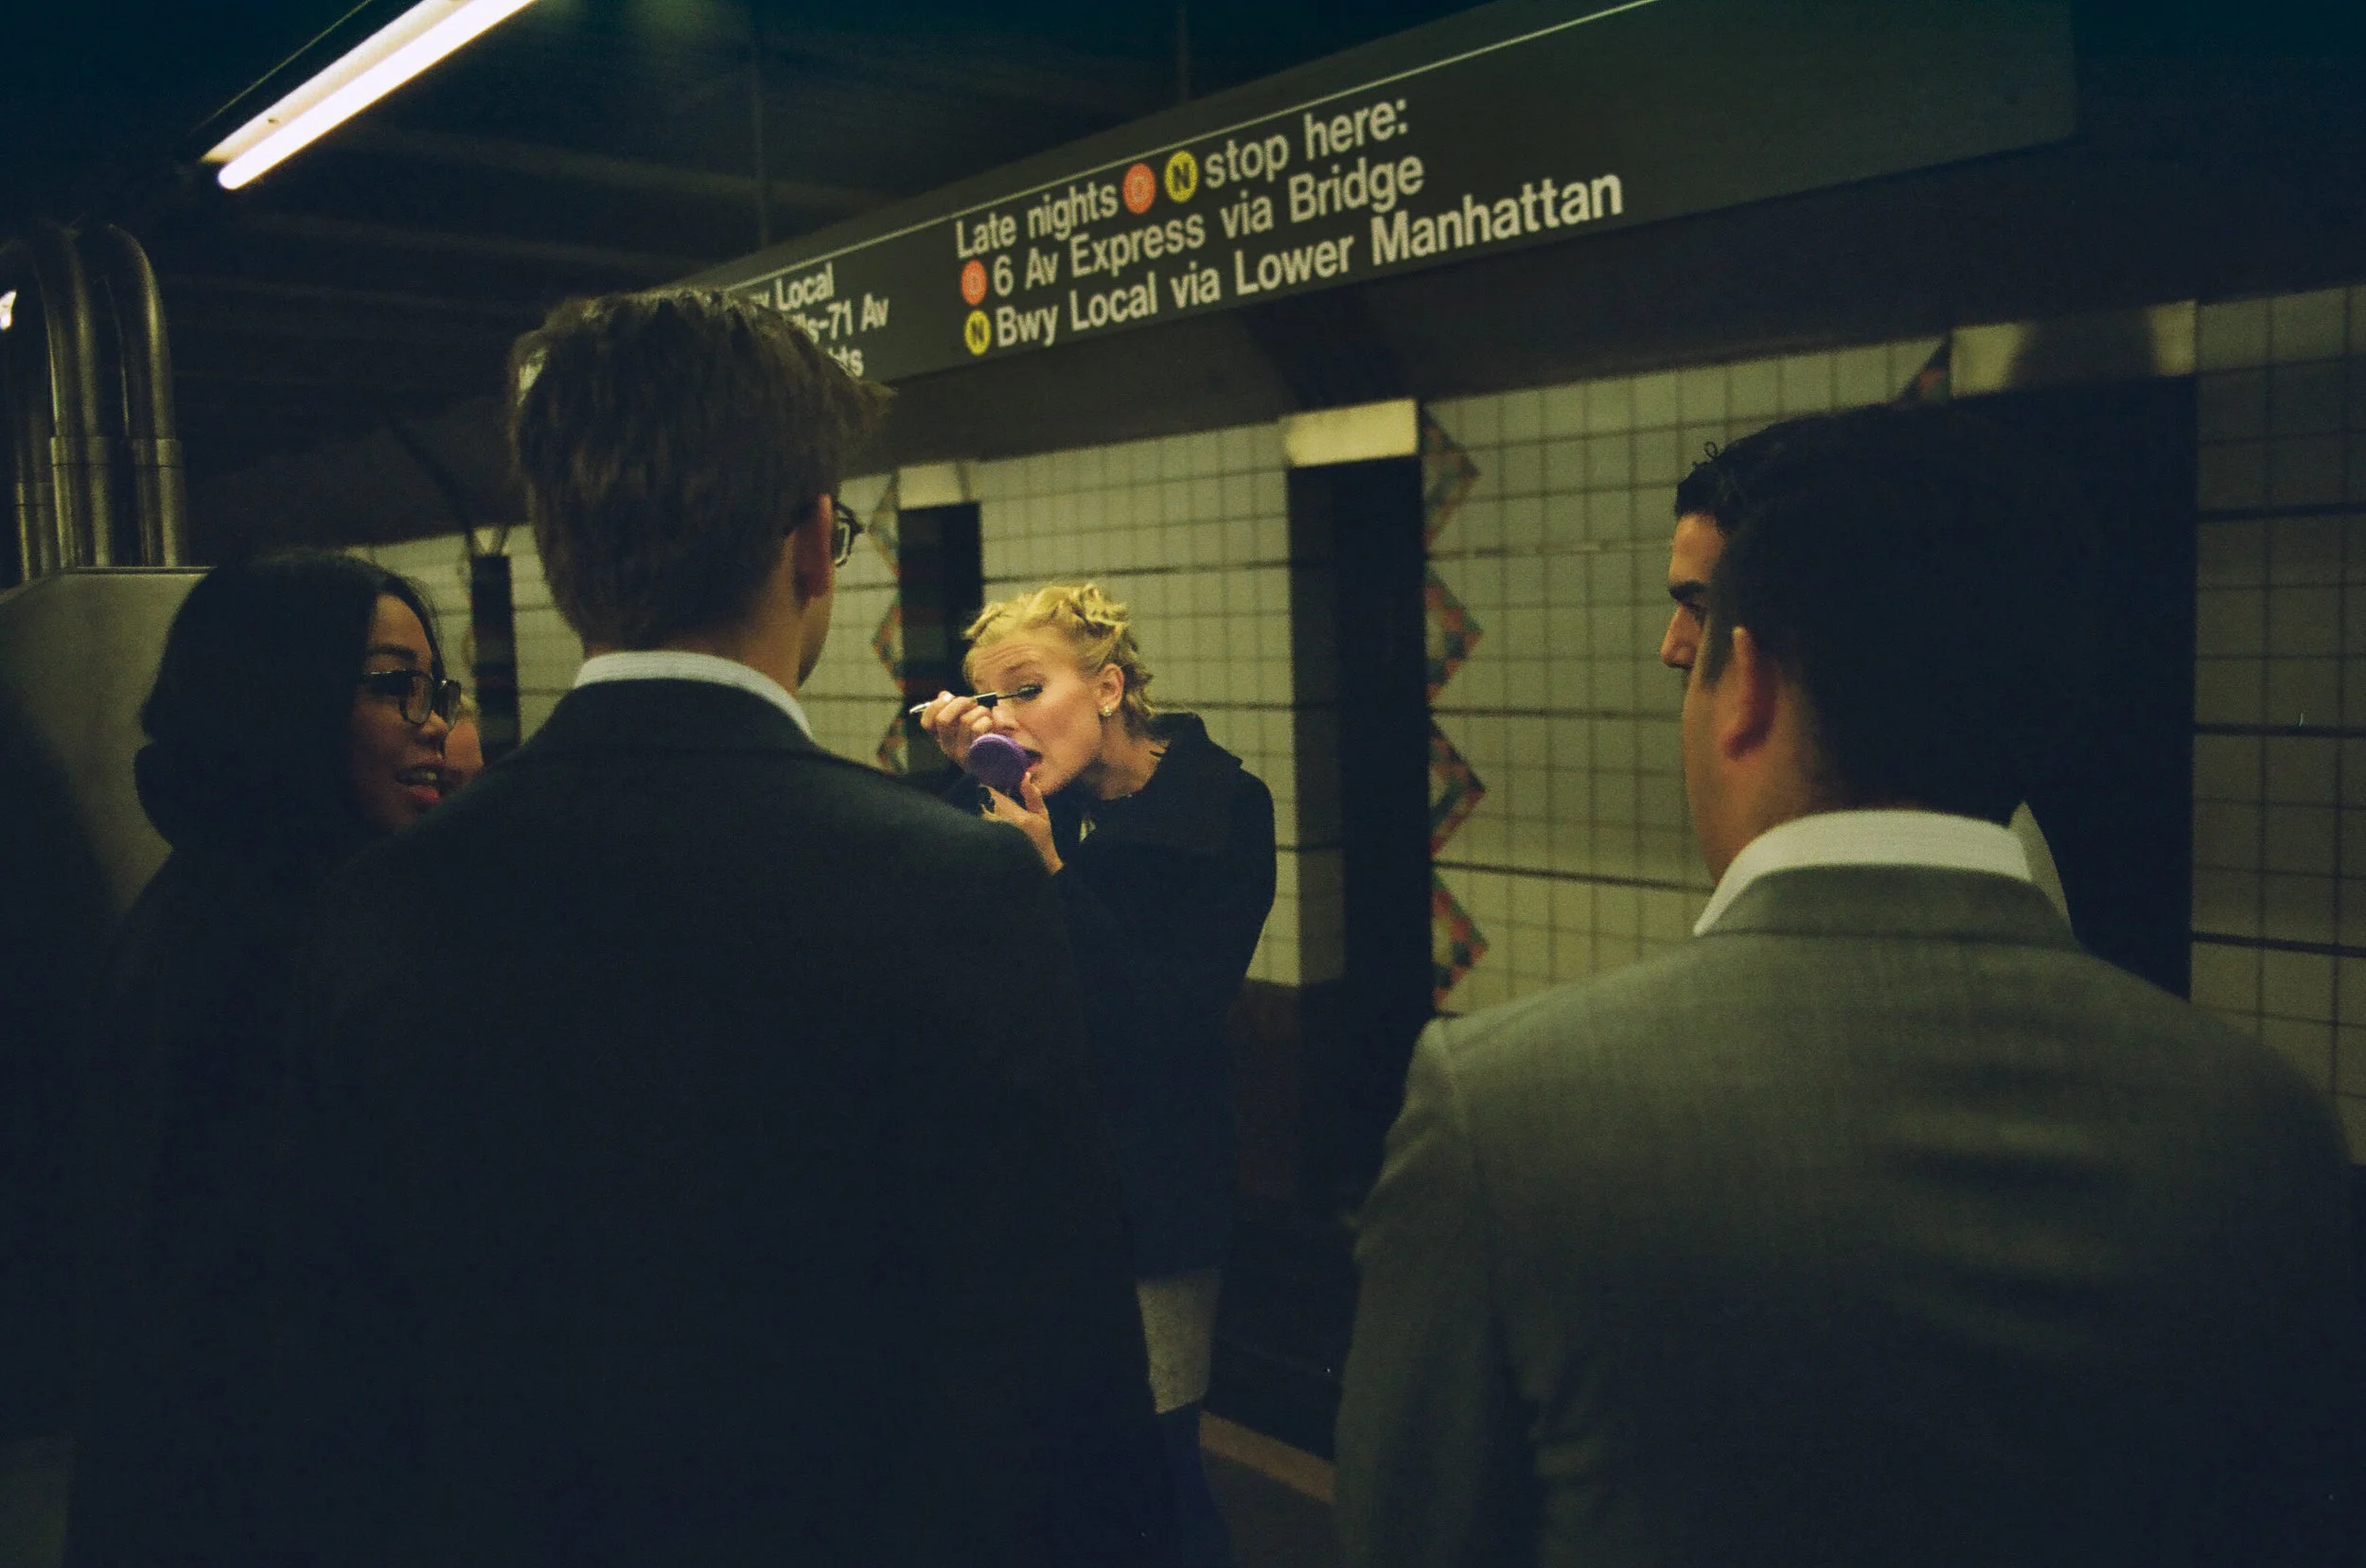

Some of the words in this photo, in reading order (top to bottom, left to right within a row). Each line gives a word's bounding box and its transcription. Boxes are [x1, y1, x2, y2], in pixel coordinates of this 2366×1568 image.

[955, 212, 1017, 260] Late
[1026, 182, 1120, 241] nights
[1169, 159, 1192, 195] N
[1204, 133, 1291, 189] stop
[1302, 97, 1408, 162] here:
[992, 254, 1015, 297] 6
[1024, 246, 1060, 291] Av
[1069, 212, 1207, 278] Express
[1220, 189, 1275, 239] via
[1288, 154, 1425, 223] Bridge
[774, 261, 835, 311] Local
[859, 291, 891, 332] Av
[995, 305, 1060, 348] Bwy
[1068, 270, 1159, 332] Local
[1169, 259, 1222, 309] via
[1233, 234, 1355, 296] Lower
[1369, 172, 1625, 268] Manhattan
